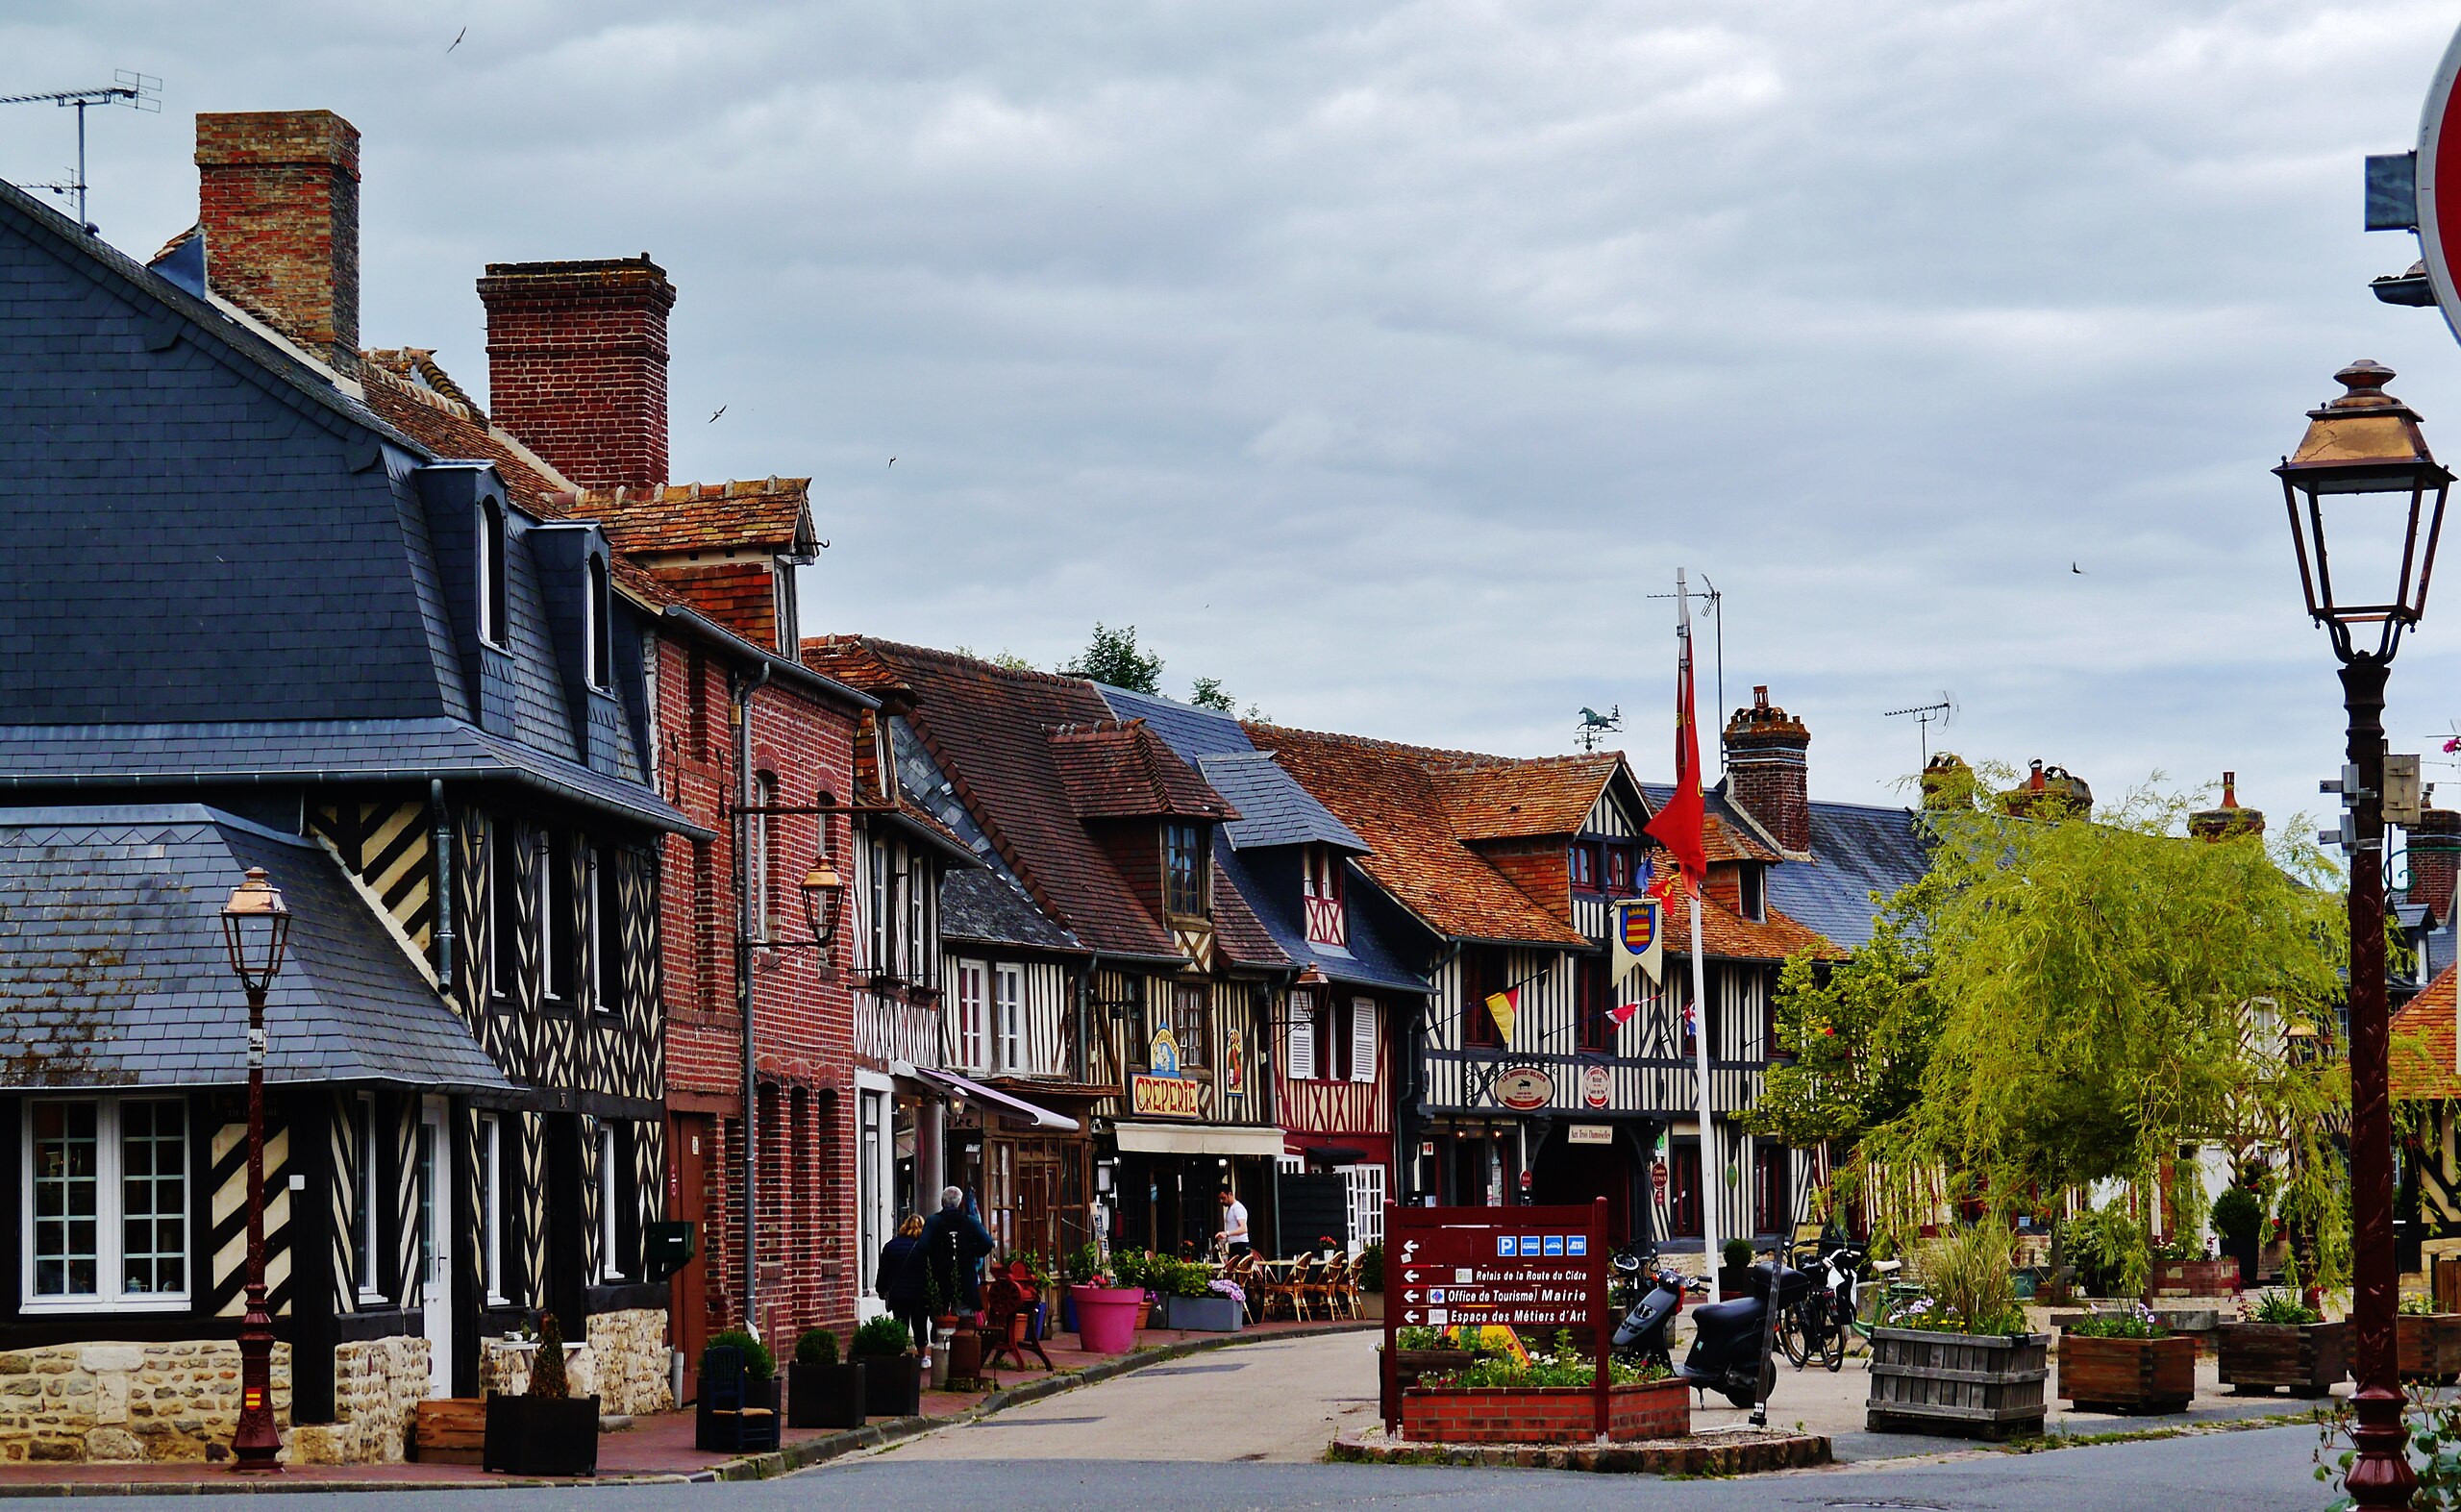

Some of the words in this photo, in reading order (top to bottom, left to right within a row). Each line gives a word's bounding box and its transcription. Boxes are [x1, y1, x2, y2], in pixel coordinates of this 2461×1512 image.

[1476, 1270, 1502, 1281] Relais
[1503, 1271, 1514, 1281] de
[1516, 1271, 1524, 1281] la
[1527, 1271, 1551, 1281] Route
[1553, 1271, 1563, 1281] du
[1566, 1271, 1587, 1281] Cidre
[1449, 1290, 1477, 1302] Office
[1479, 1290, 1490, 1302] de
[1542, 1289, 1587, 1301] Mairie
[1452, 1310, 1488, 1326] Espace
[1492, 1310, 1510, 1323] des
[1514, 1310, 1555, 1323] Métiers
